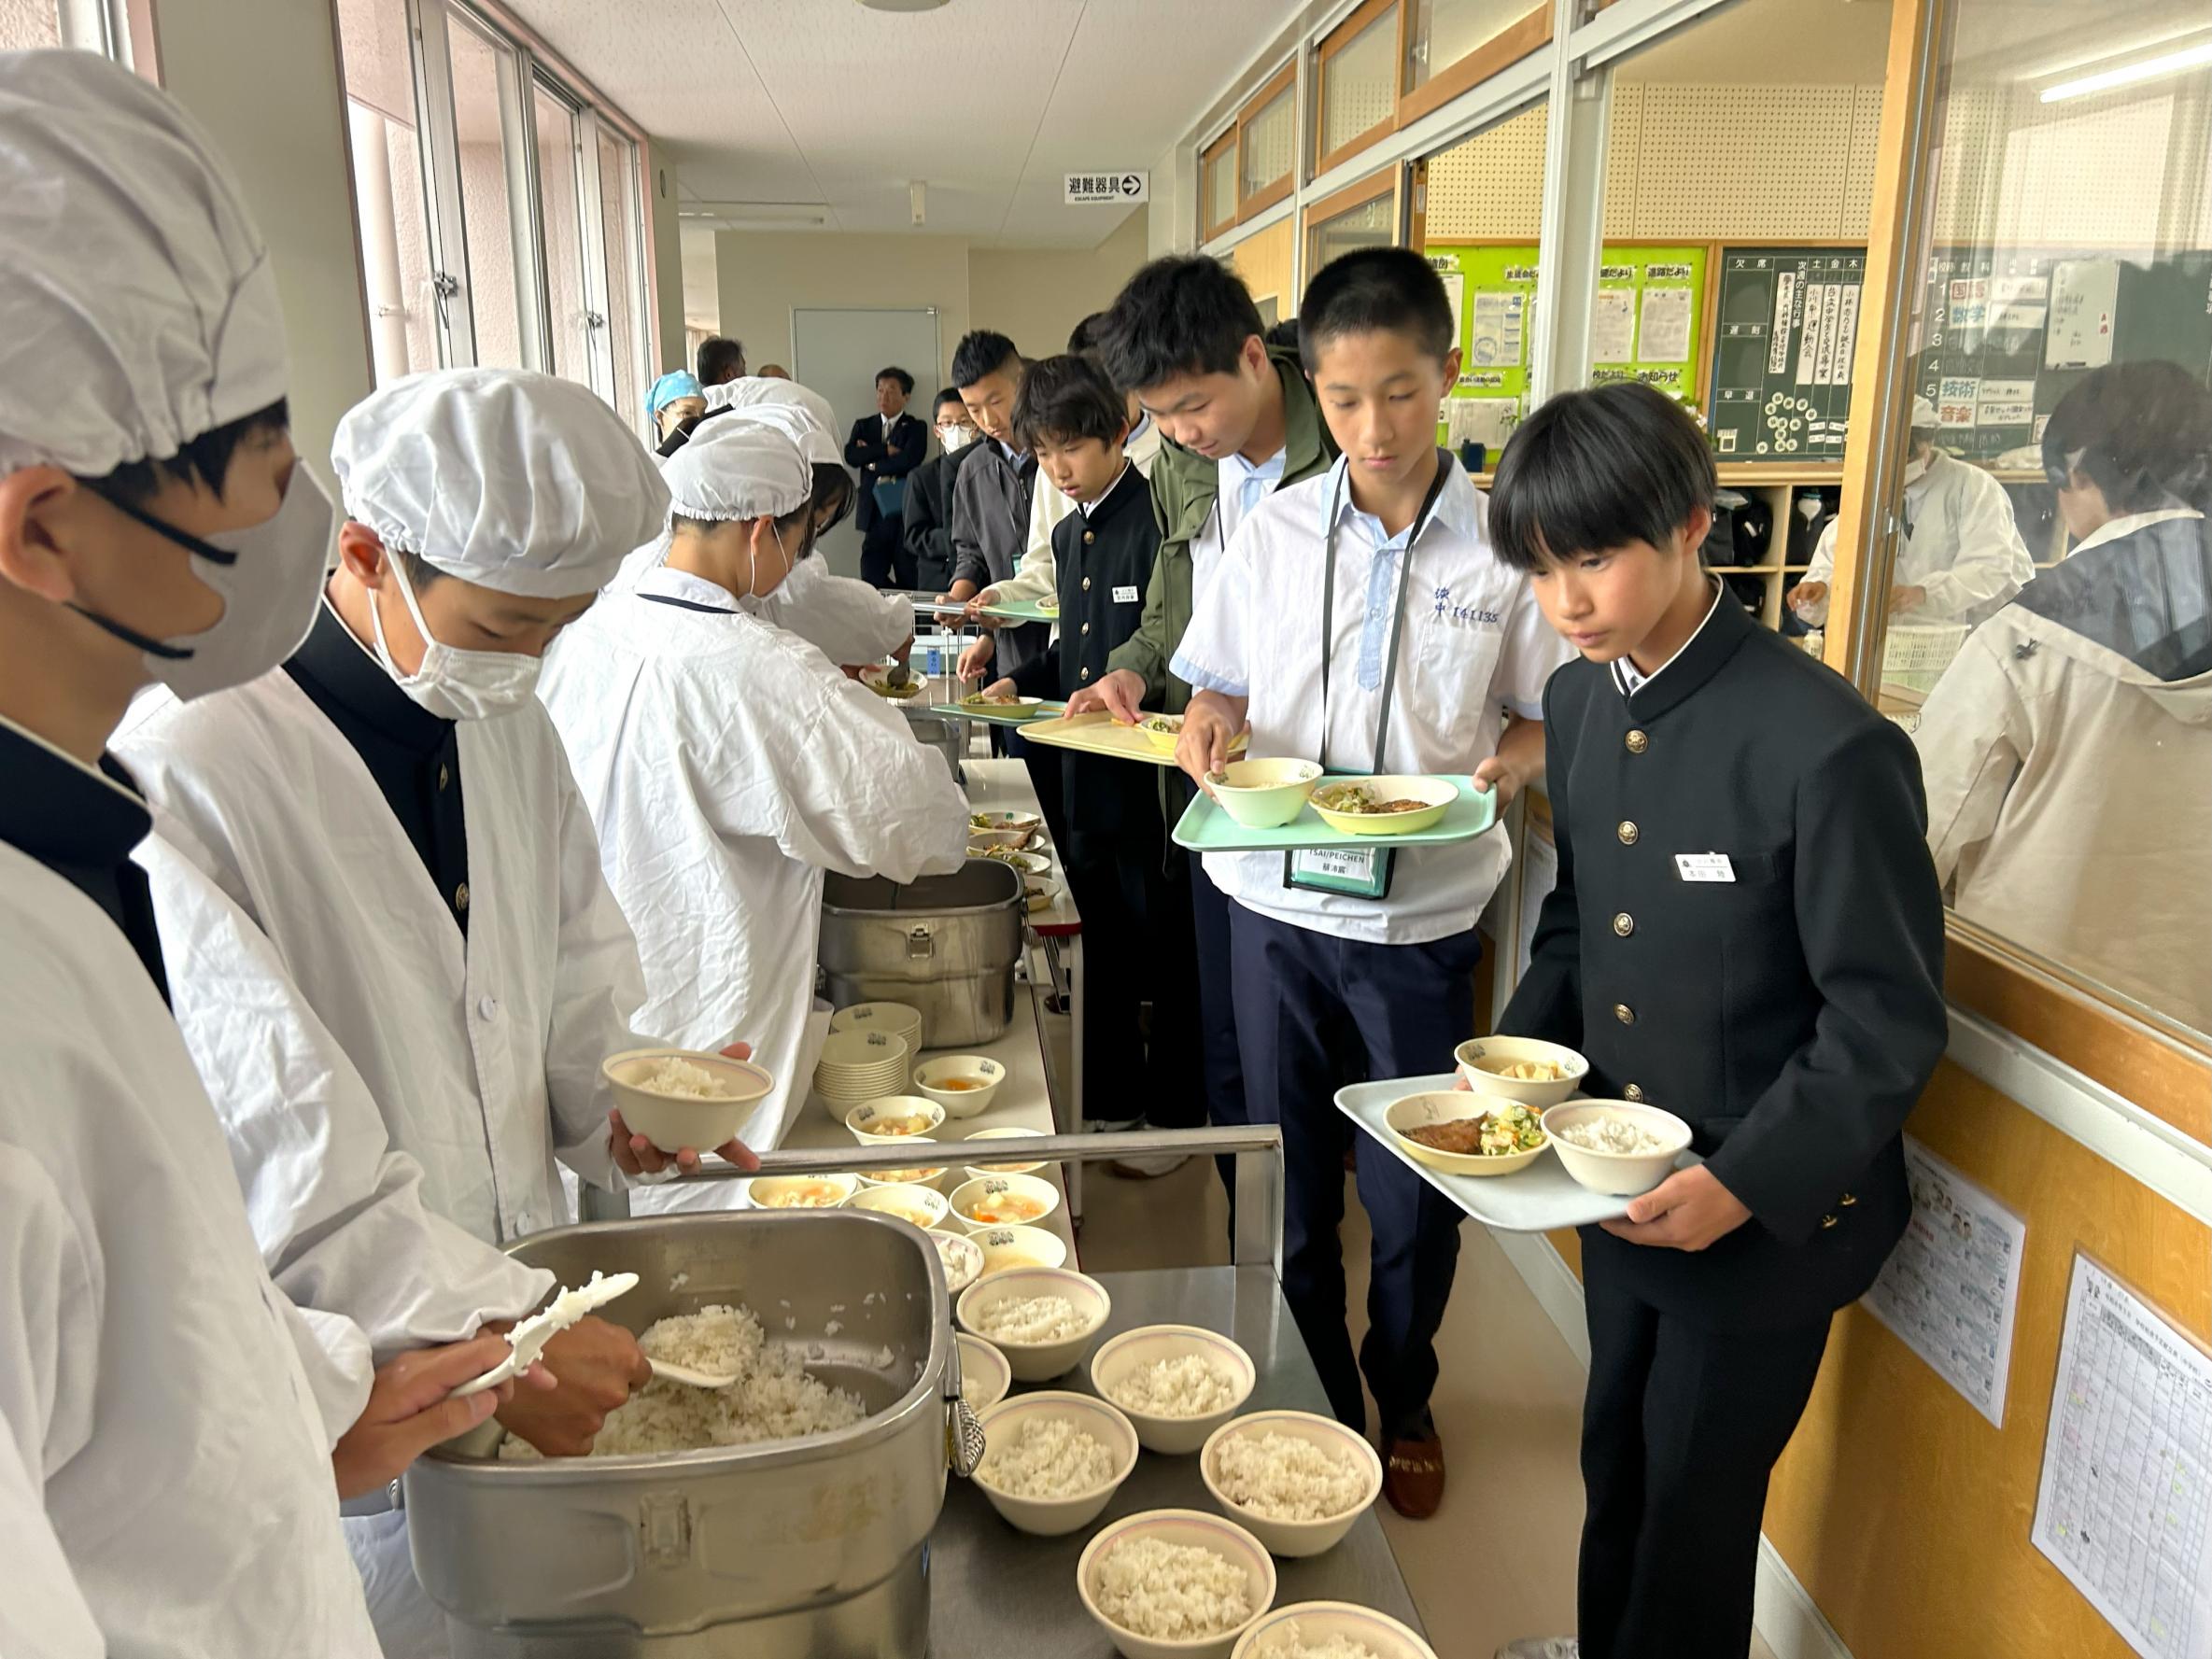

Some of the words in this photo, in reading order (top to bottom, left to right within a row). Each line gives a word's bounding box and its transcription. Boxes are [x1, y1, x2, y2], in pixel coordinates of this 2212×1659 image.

[1069, 176, 1120, 194] 避難器具
[1735, 259, 1768, 269] 欠席
[1812, 260, 1822, 269] 土
[1830, 259, 1840, 269] 金
[1849, 259, 1859, 269] 木
[1939, 283, 1946, 296] 1
[1935, 308, 1946, 322] 2
[1932, 333, 1942, 347] 3
[1928, 359, 1939, 372] 4
[1638, 371, 1679, 383] お知らせ
[1925, 384, 1937, 398] 5
[1943, 380, 1976, 399] 技術
[1940, 404, 1973, 423] 音楽
